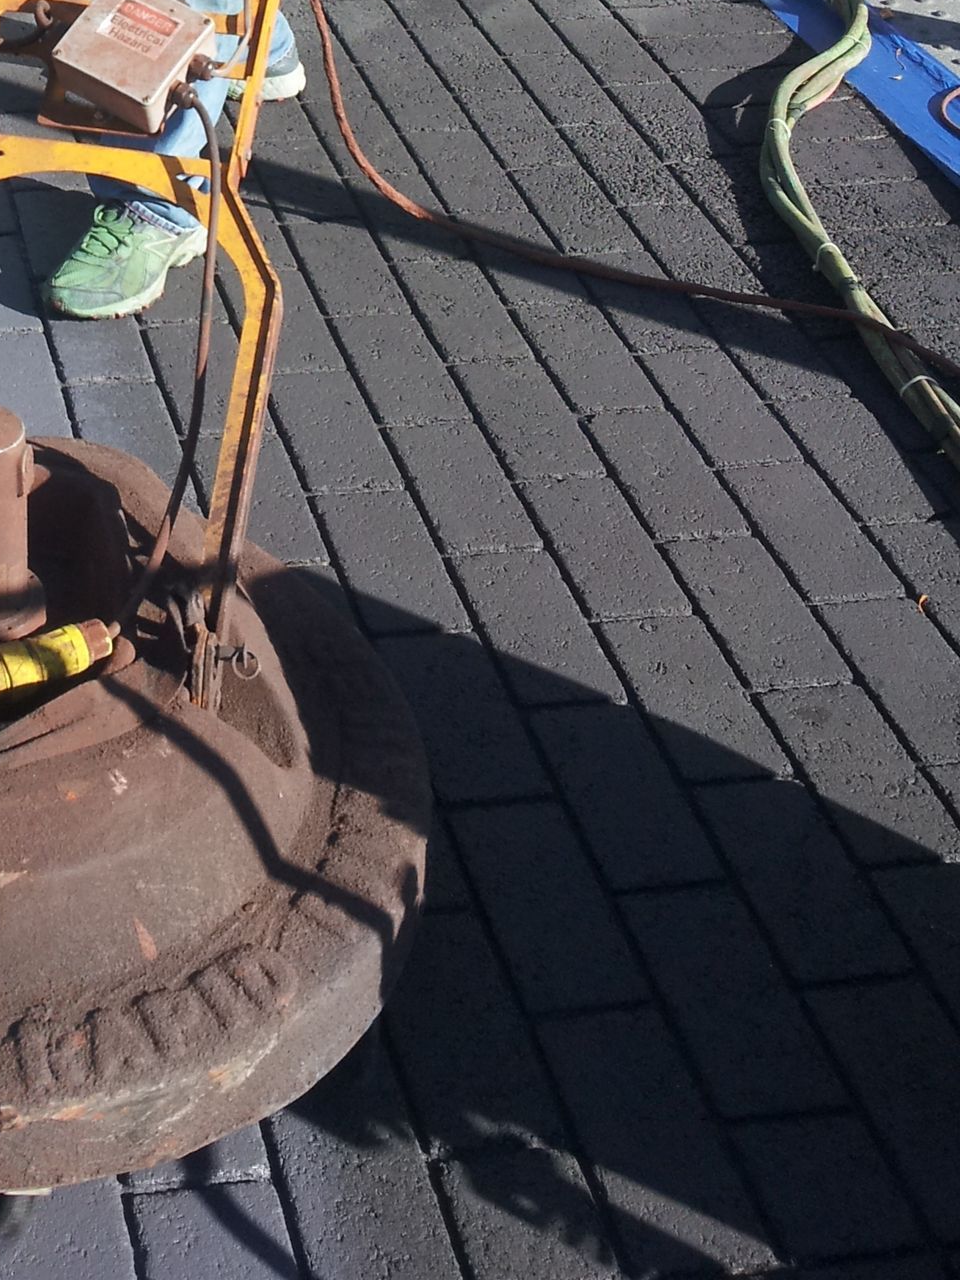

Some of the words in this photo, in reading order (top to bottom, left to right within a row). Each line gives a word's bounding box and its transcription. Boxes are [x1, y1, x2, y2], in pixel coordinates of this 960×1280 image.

[110, 14, 166, 47] Electrical
[123, 2, 173, 34] DANGER
[108, 26, 152, 54] Hazard
